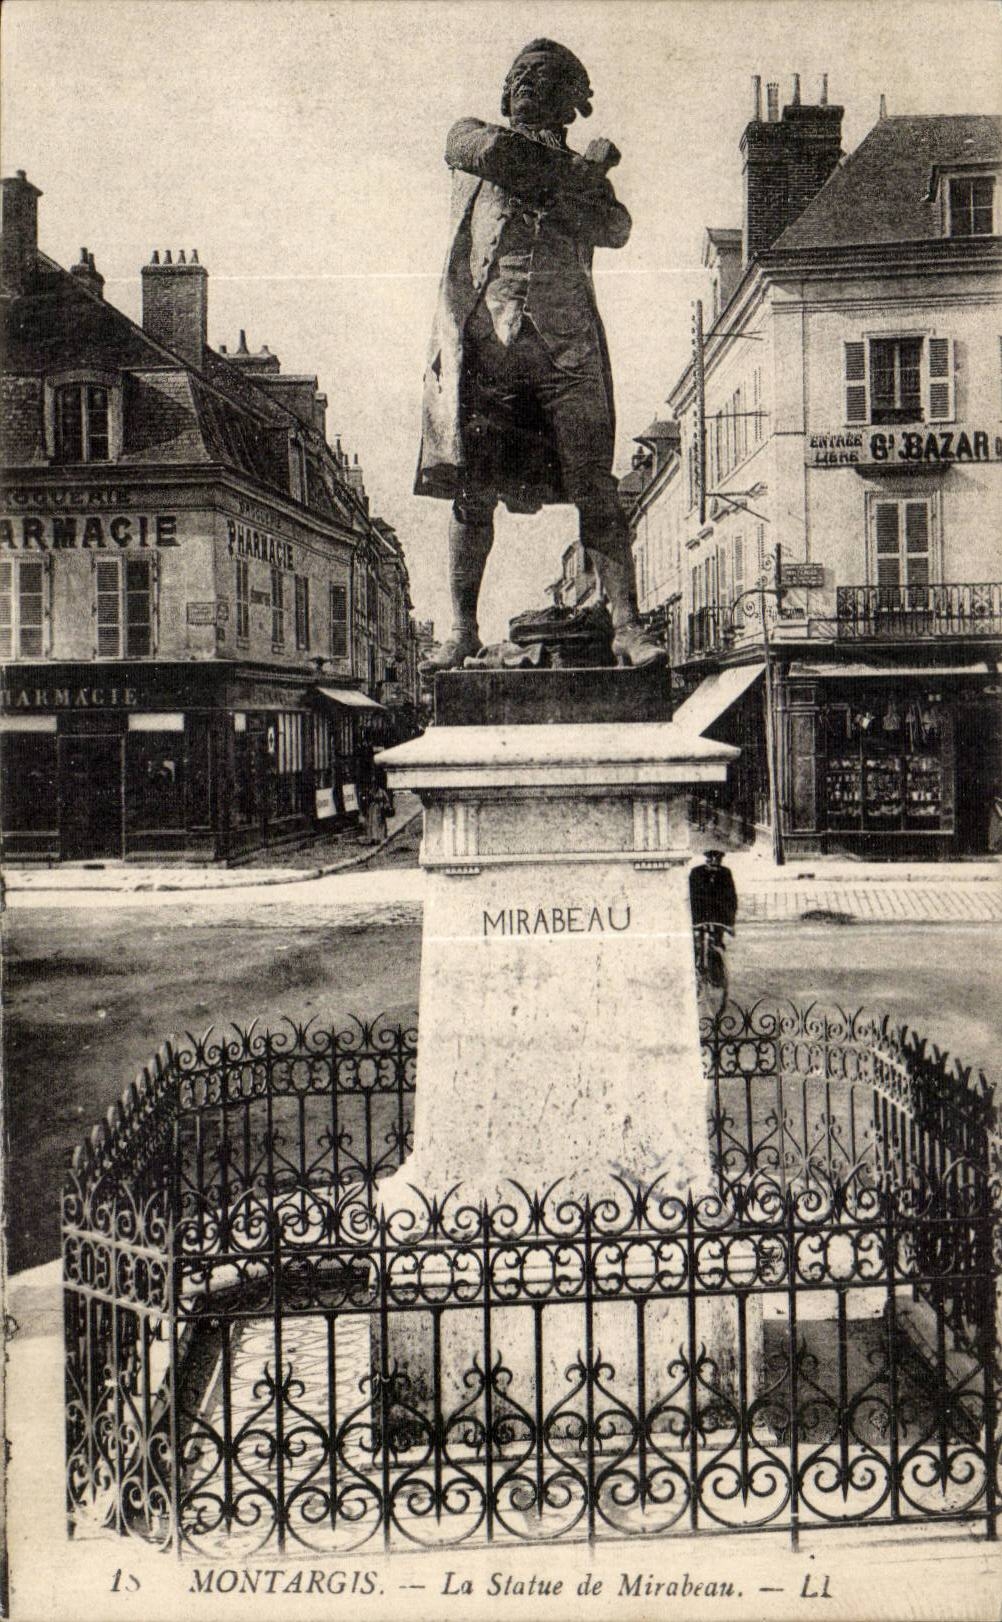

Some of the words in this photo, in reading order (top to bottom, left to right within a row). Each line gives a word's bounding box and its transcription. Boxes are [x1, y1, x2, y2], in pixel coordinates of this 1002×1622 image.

[898, 431, 989, 460] BAZAR
[226, 519, 294, 570] PHARMACIE
[483, 906, 631, 936] MIRABEAU
